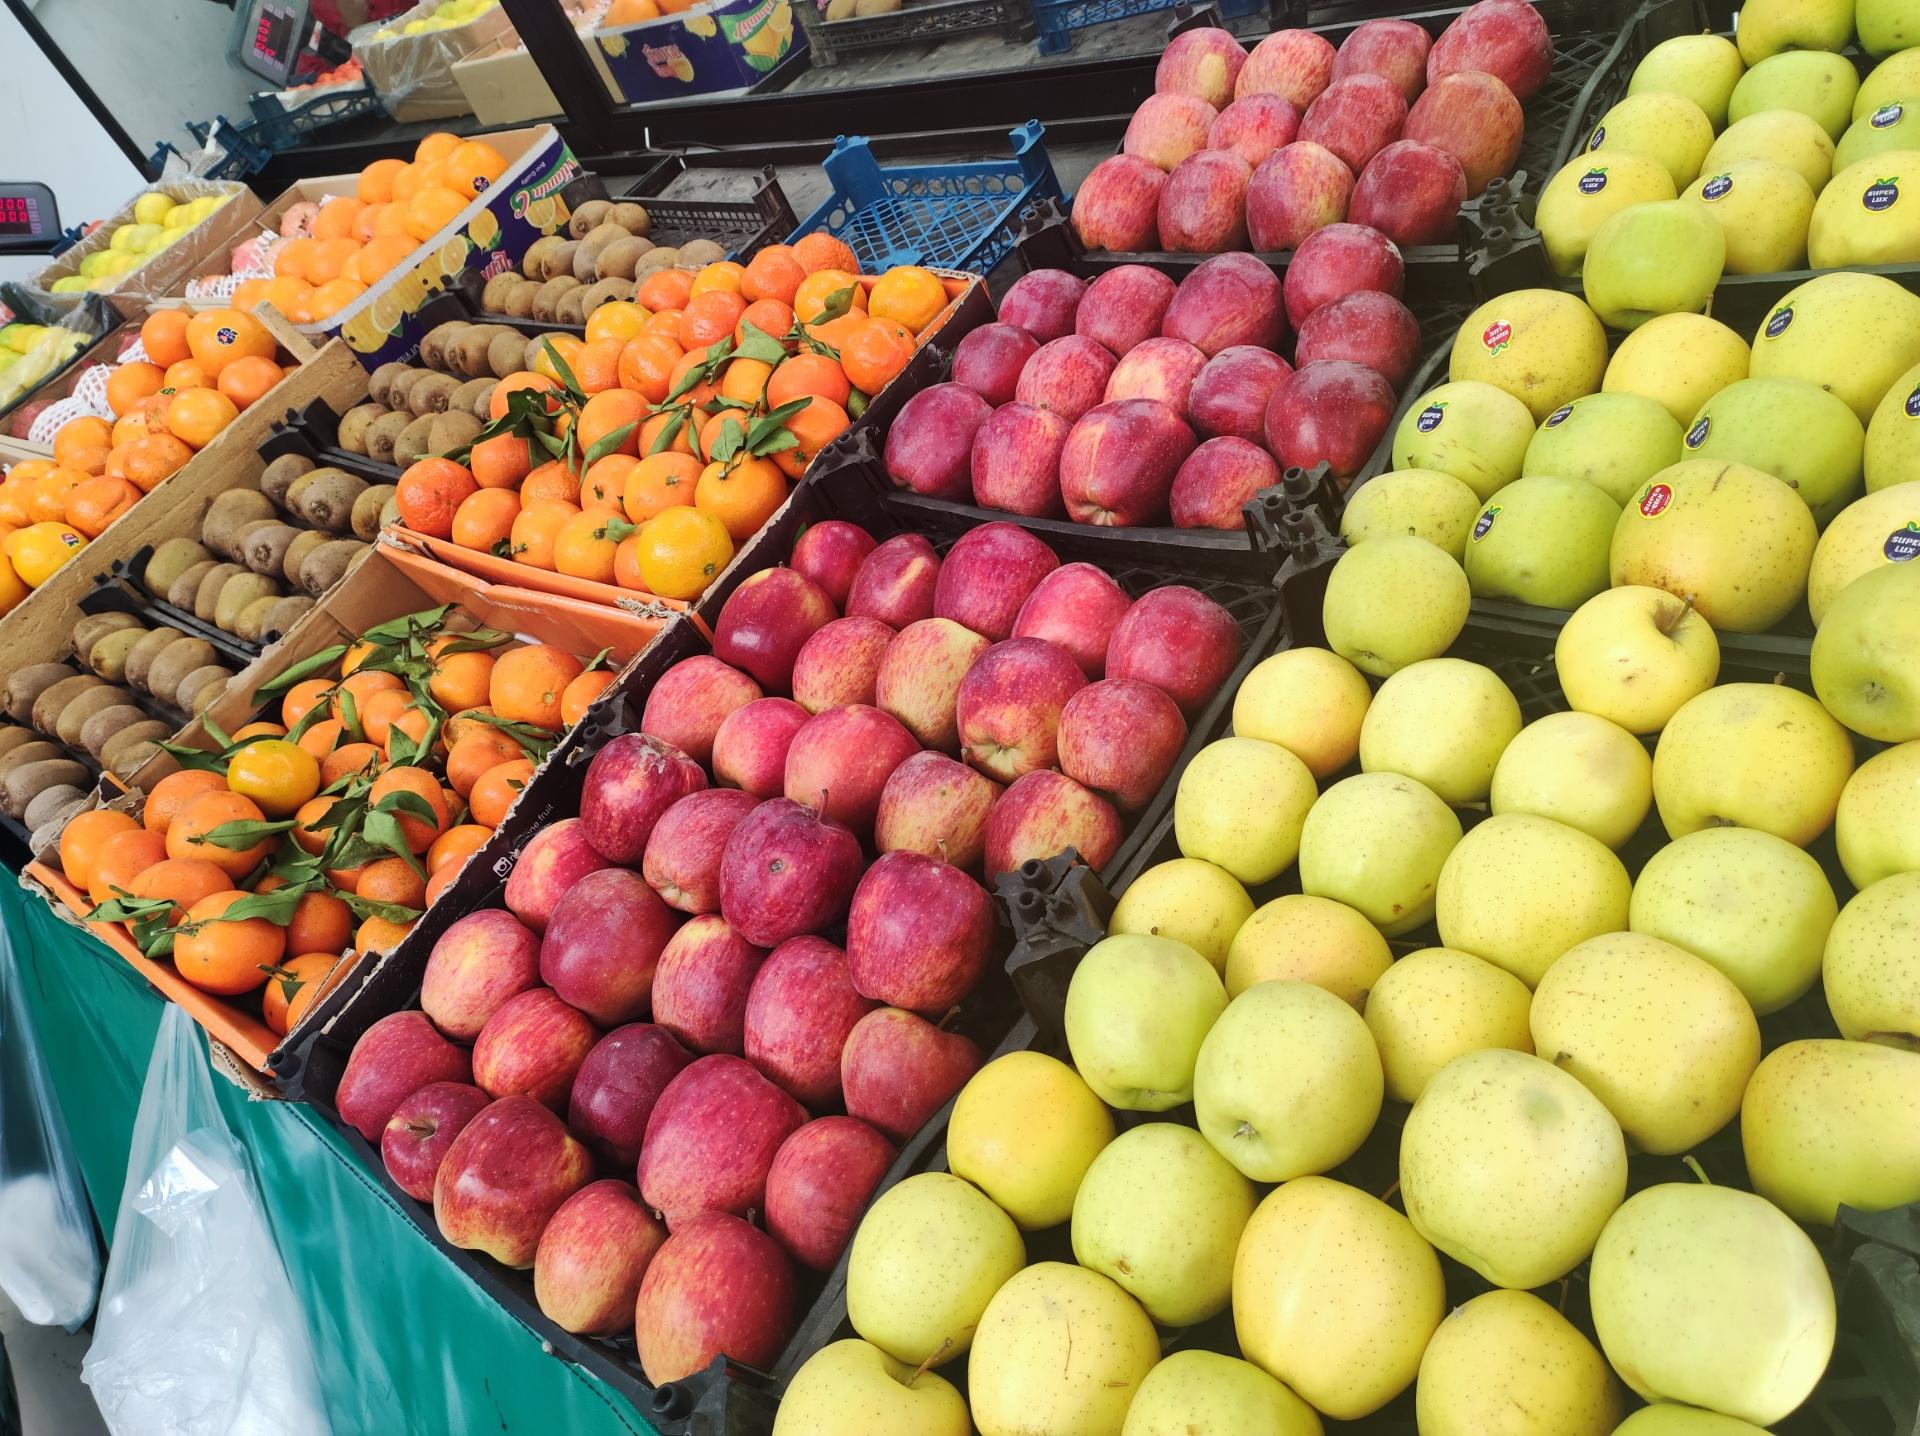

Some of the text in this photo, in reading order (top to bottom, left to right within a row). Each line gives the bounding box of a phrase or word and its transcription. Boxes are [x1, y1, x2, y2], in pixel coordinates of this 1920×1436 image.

[1867, 189, 1895, 197] SUPER
[513, 190, 530, 220] C
[1769, 312, 1790, 328] SUPER
[1771, 320, 1785, 331] LUX
[1891, 536, 1920, 546] SUPE
[1894, 545, 1915, 554] LUX
